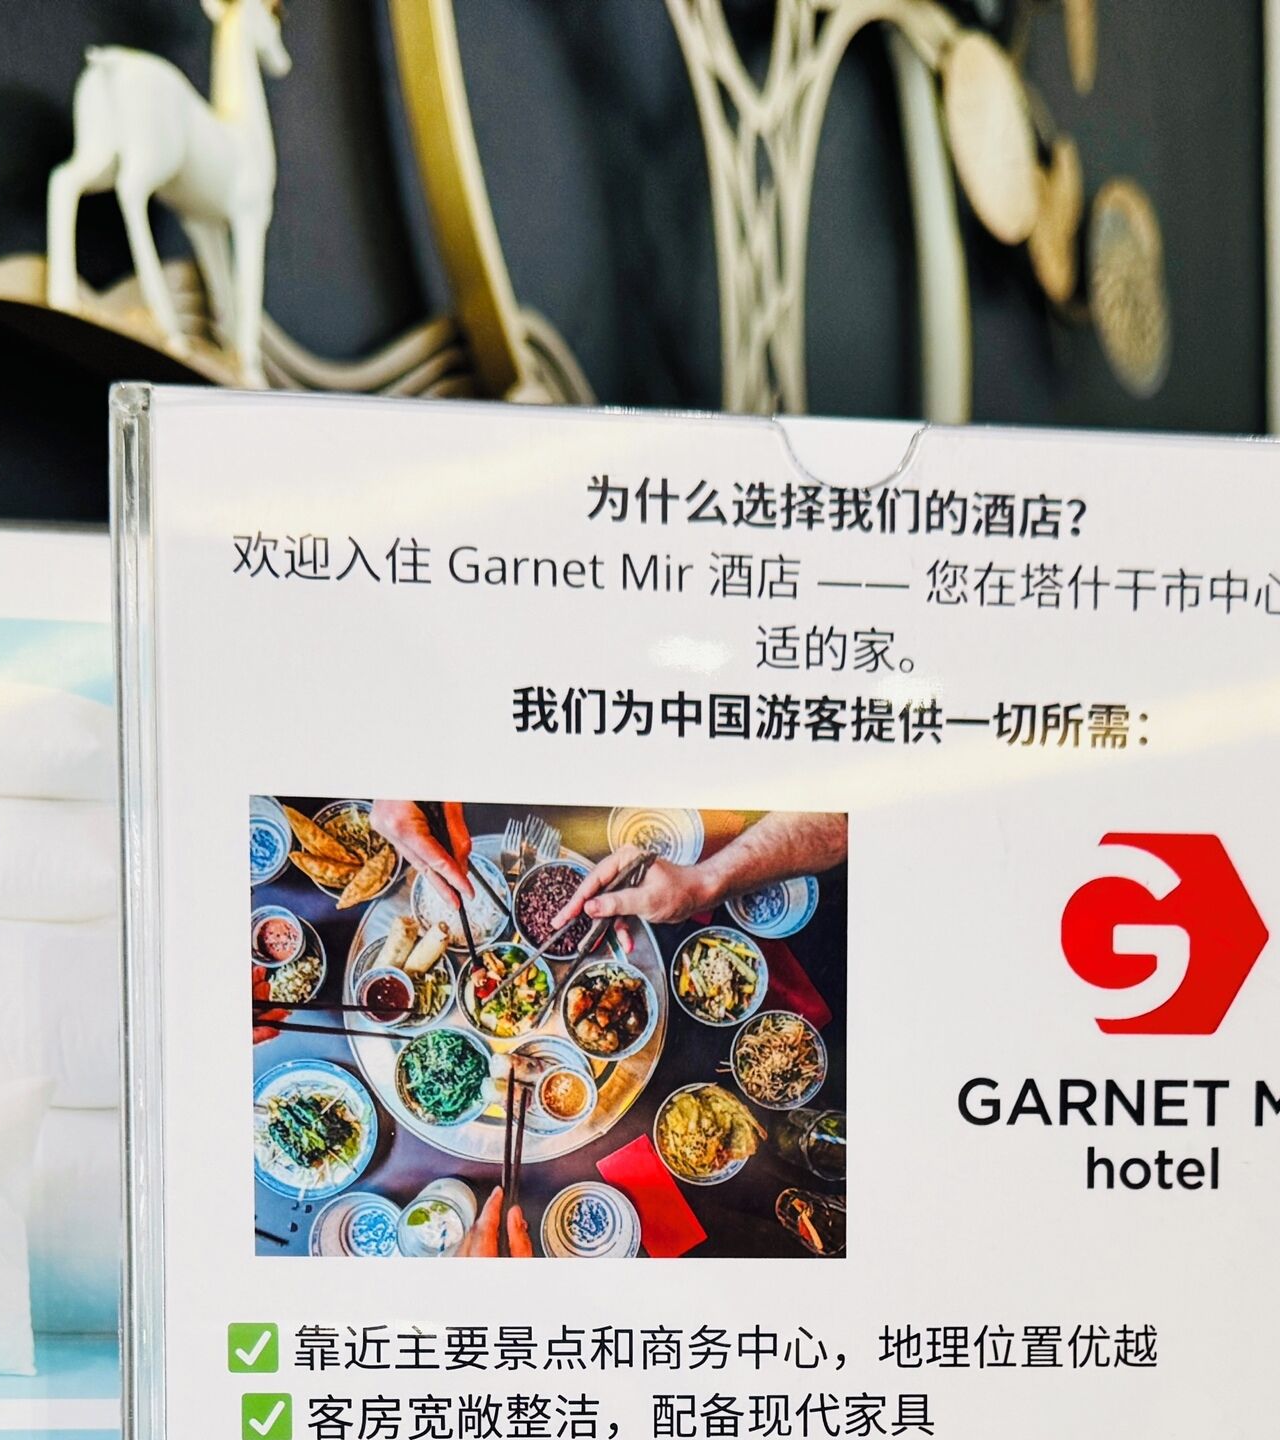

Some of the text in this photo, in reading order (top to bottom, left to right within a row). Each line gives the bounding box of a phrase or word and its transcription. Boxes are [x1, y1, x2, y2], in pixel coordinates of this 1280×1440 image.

[587, 475, 1086, 539] 为什么选择我们的酒店？
[233, 531, 431, 584] 欢迎入住
[449, 546, 604, 589] Garnet
[623, 553, 693, 592] Mir
[710, 552, 800, 599] 酒店
[756, 625, 918, 673] 适的家。
[958, 1077, 1229, 1126] GARNET
[1087, 1146, 1219, 1190] hotel
[294, 1324, 1157, 1371] 靠近主要景点和商务中心，地理位置优越
[308, 1392, 934, 1440] 客房宽敞整洁，配备现代家具
